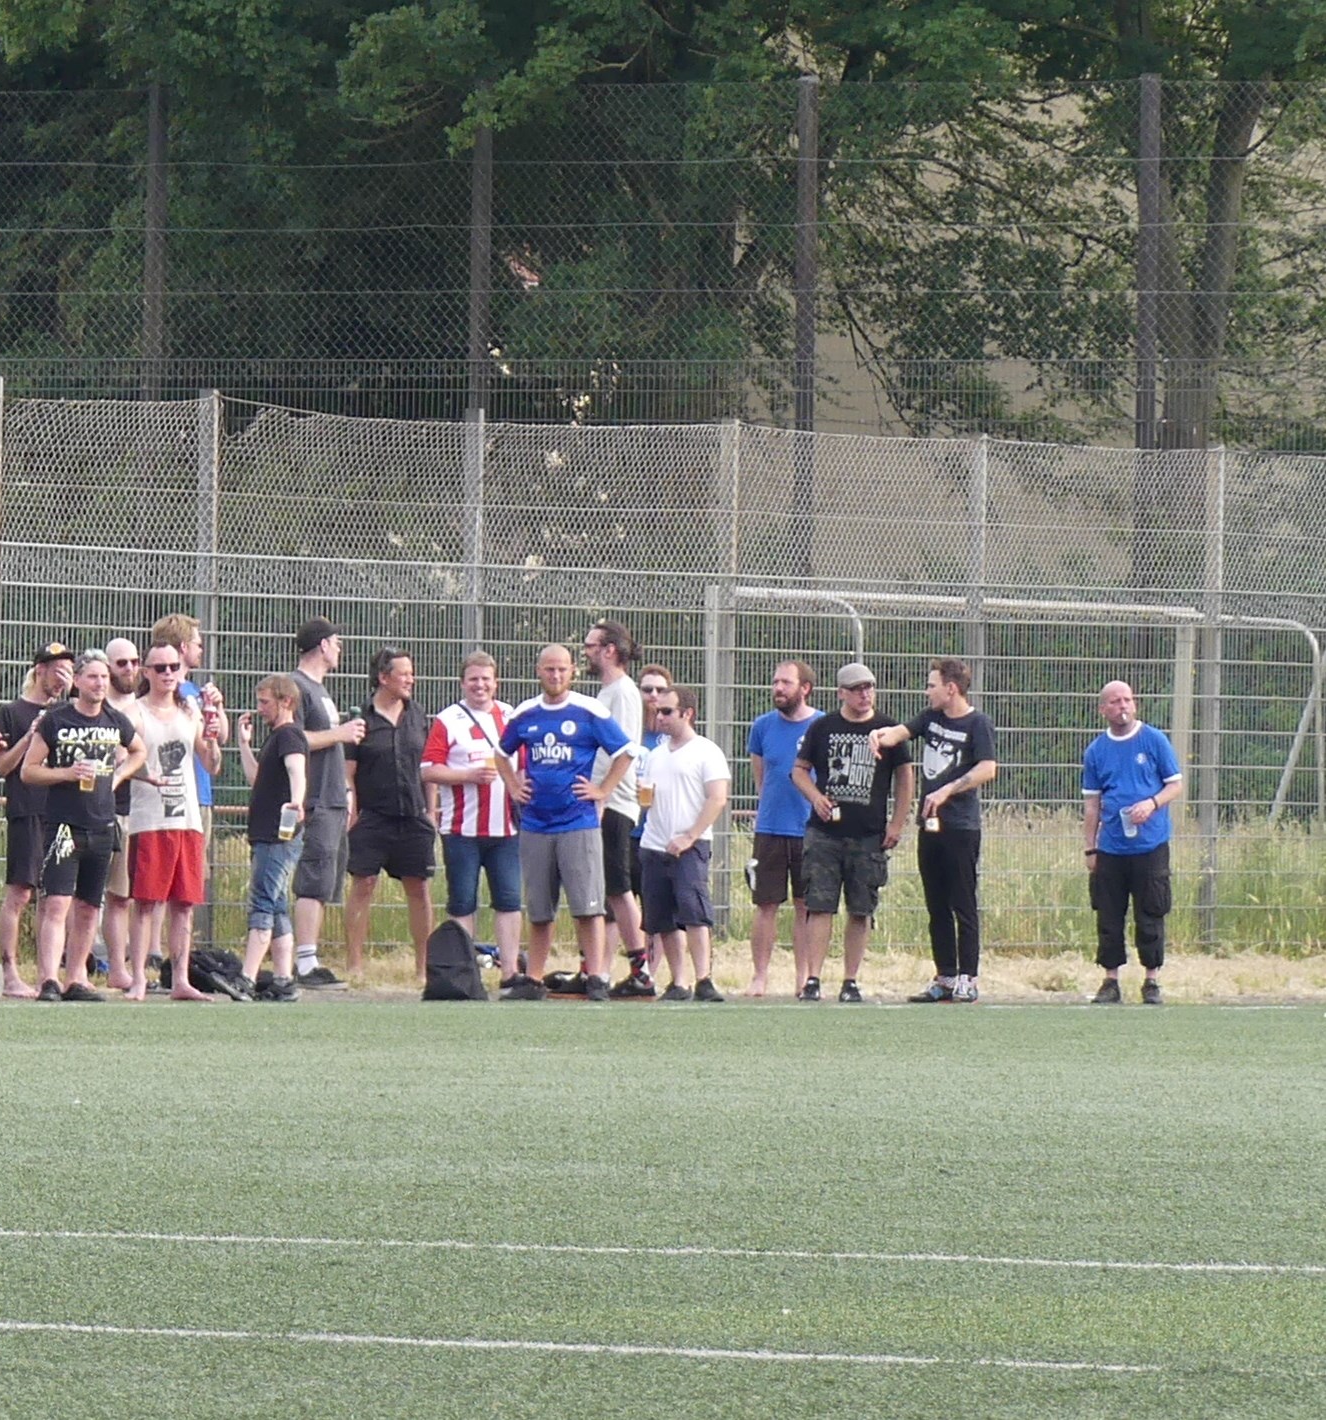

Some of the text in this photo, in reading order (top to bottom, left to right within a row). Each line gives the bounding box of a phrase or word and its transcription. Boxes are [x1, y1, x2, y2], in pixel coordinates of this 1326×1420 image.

[57, 726, 121, 741] CANTONA
[531, 744, 572, 761] UNION
[848, 764, 875, 788] BOYS
